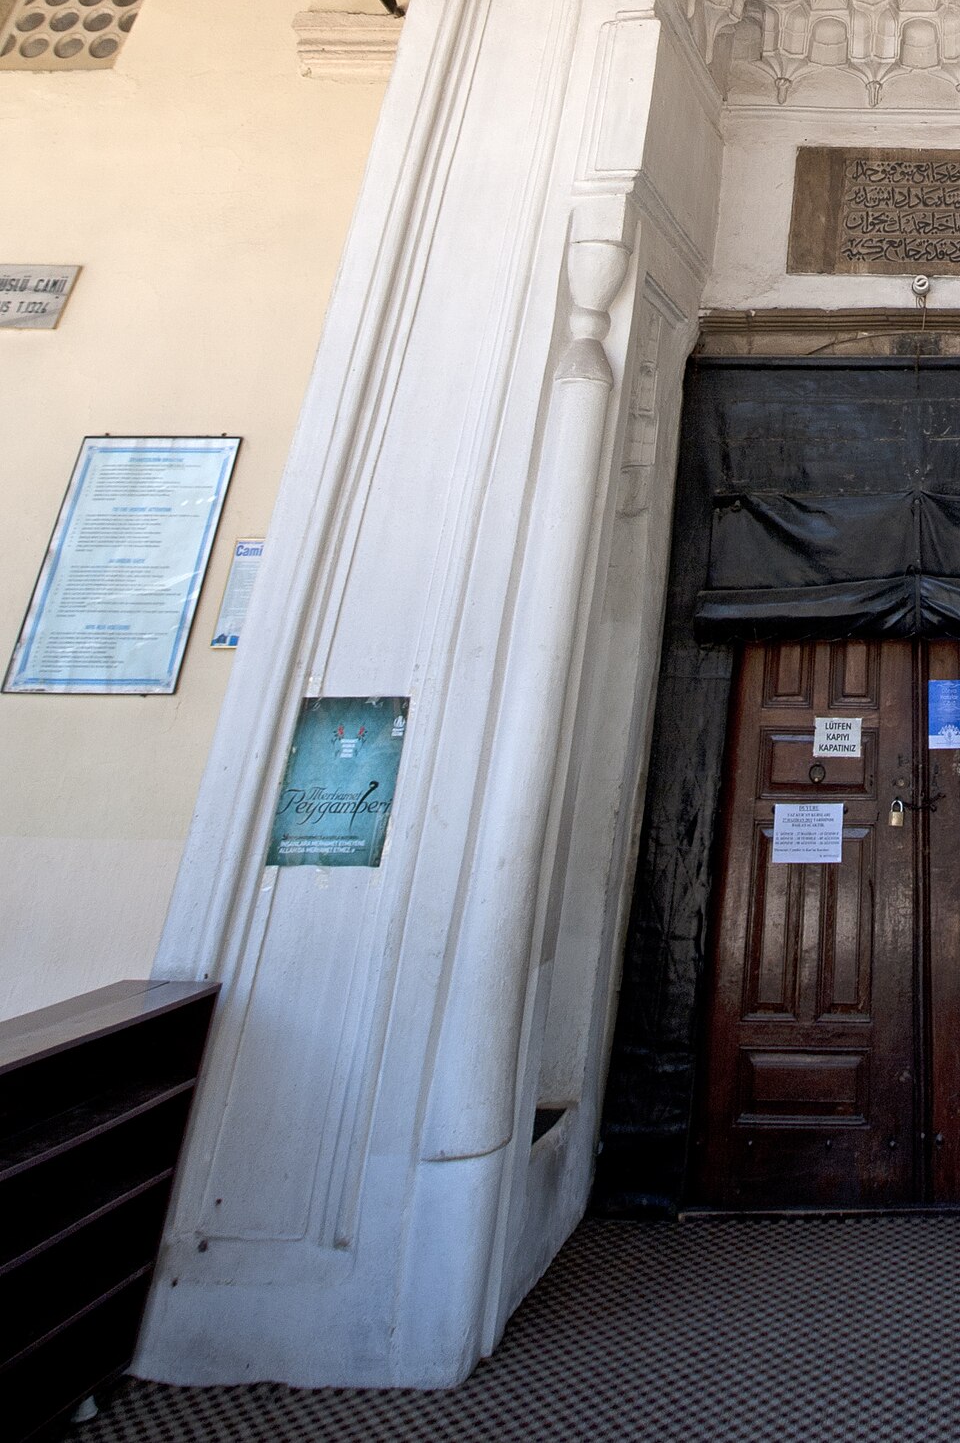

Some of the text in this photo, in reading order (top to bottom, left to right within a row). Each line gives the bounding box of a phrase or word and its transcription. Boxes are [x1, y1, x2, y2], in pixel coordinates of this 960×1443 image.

[825, 720, 852, 730] LÜTFEN
[826, 733, 850, 741] KAPIYI
[818, 744, 856, 752] KAPATINIZ
[306, 786, 363, 801] Merhamet
[276, 783, 393, 827] Peygamberi
